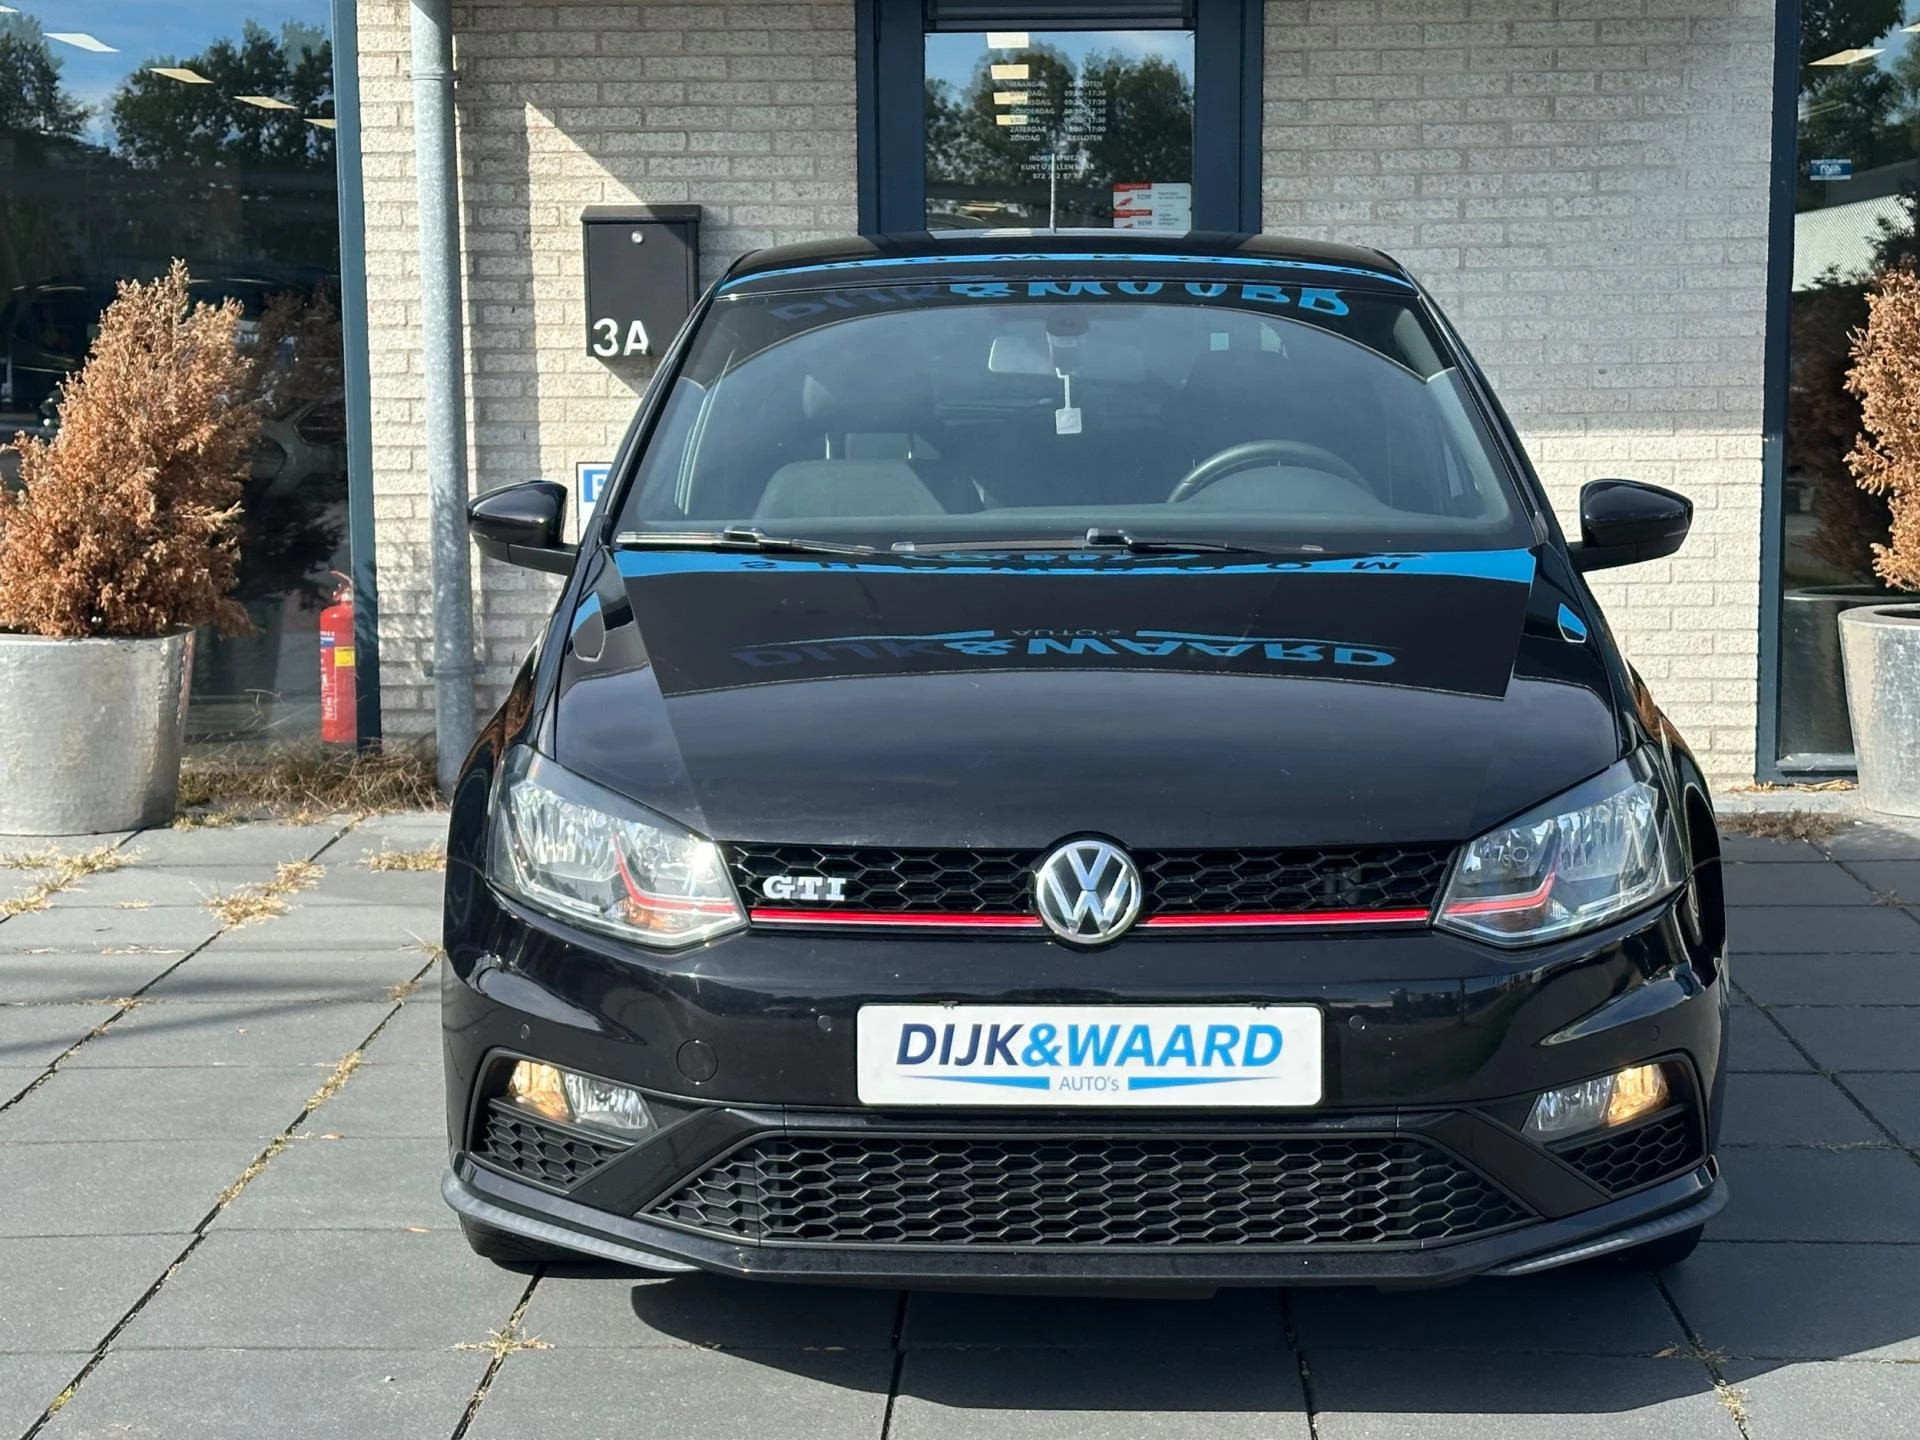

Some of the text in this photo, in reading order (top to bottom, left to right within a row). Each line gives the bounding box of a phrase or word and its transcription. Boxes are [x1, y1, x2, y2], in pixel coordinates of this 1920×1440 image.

[593, 318, 648, 357] 3A
[763, 876, 847, 900] GTI
[896, 1023, 1283, 1067] DIJK&WAARD
